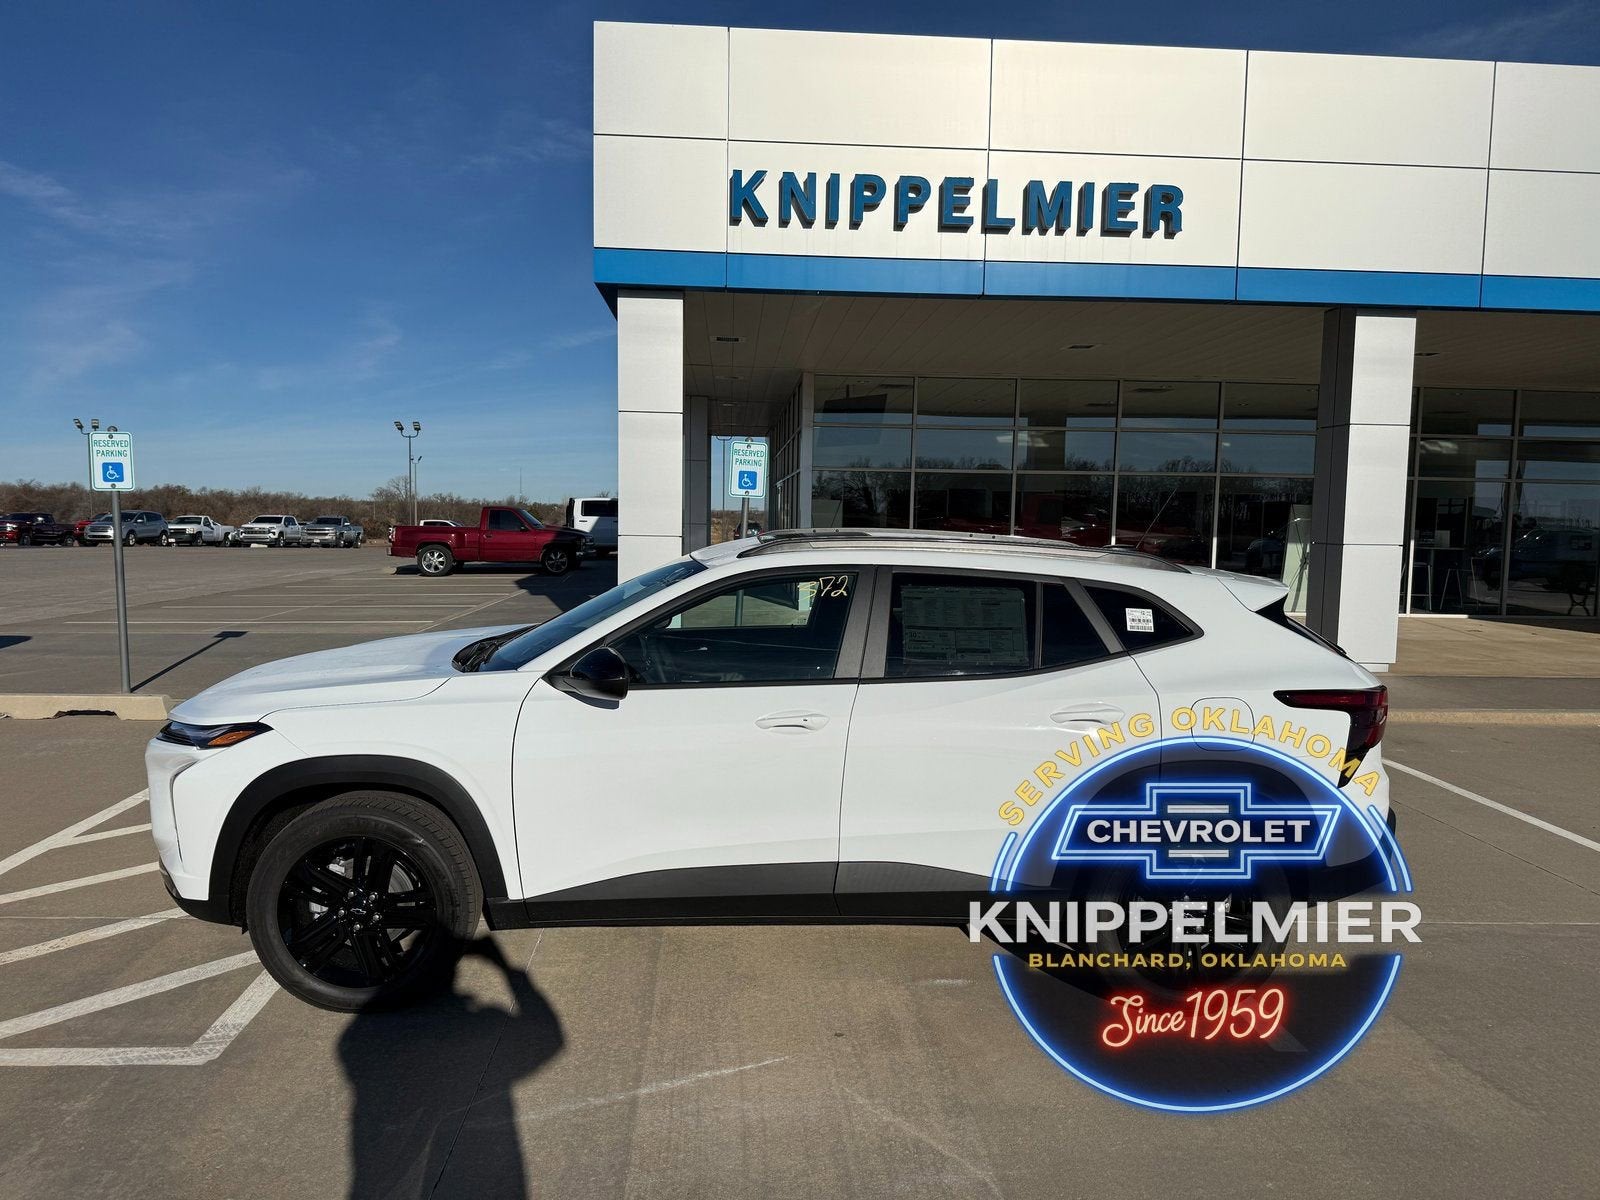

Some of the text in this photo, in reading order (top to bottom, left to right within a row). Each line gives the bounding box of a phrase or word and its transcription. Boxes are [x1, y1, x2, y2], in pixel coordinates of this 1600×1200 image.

[729, 169, 1184, 239] KNIPPELMIER
[93, 439, 129, 448] RESERVED
[96, 449, 128, 458] PARKING
[733, 448, 765, 458] RESERVED
[735, 458, 762, 467] PARKING
